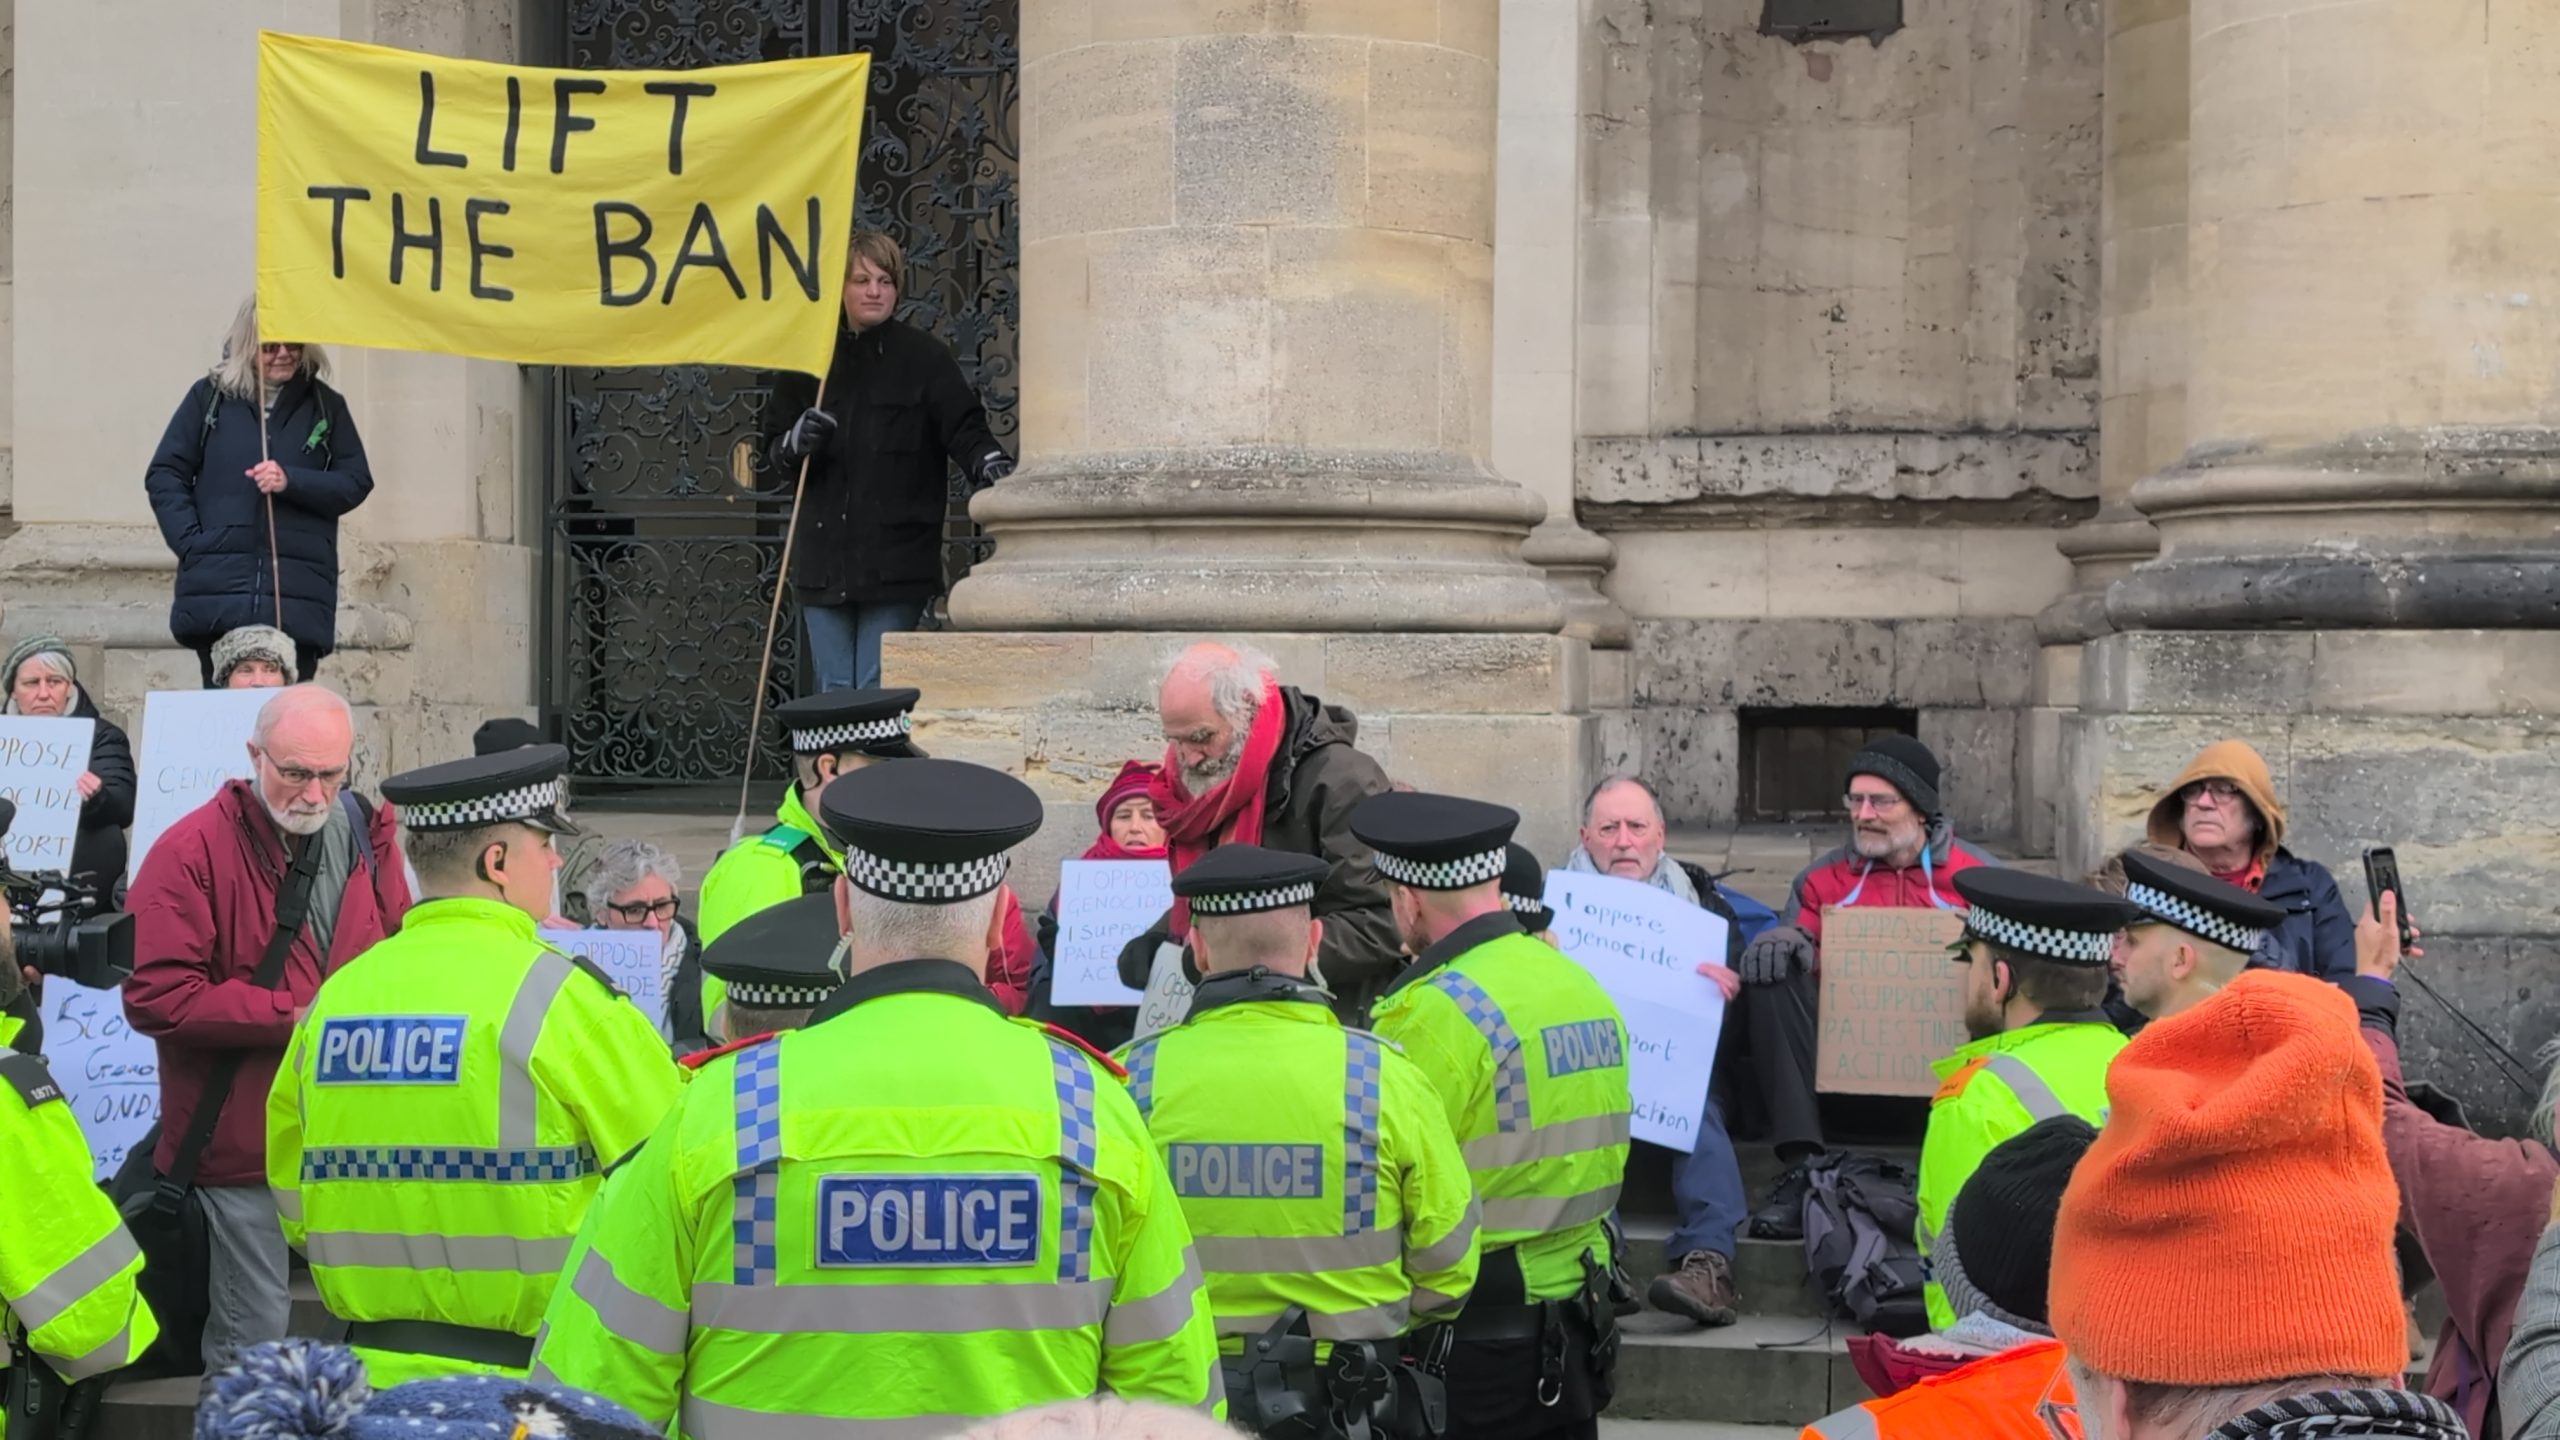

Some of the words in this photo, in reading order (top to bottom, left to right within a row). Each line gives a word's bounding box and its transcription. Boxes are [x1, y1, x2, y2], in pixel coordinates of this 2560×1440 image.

[415, 70, 716, 175] LIFT
[307, 186, 514, 301] THE
[594, 196, 820, 306] BAN
[1067, 894, 1169, 917] GENOCIDE
[1584, 903, 1666, 935] oppose
[1563, 926, 1682, 972] genocide
[1845, 914, 1945, 945] OPPOSE
[571, 941, 655, 969] OPPOSE
[1827, 950, 1957, 980] GENOCIDE
[1849, 983, 1959, 1013] SUPPORT
[322, 1026, 457, 1074] POLICE
[1544, 1021, 1621, 1075] POLICE
[1176, 1144, 1316, 1197] POLICE
[829, 1189, 1031, 1252] POLICE
